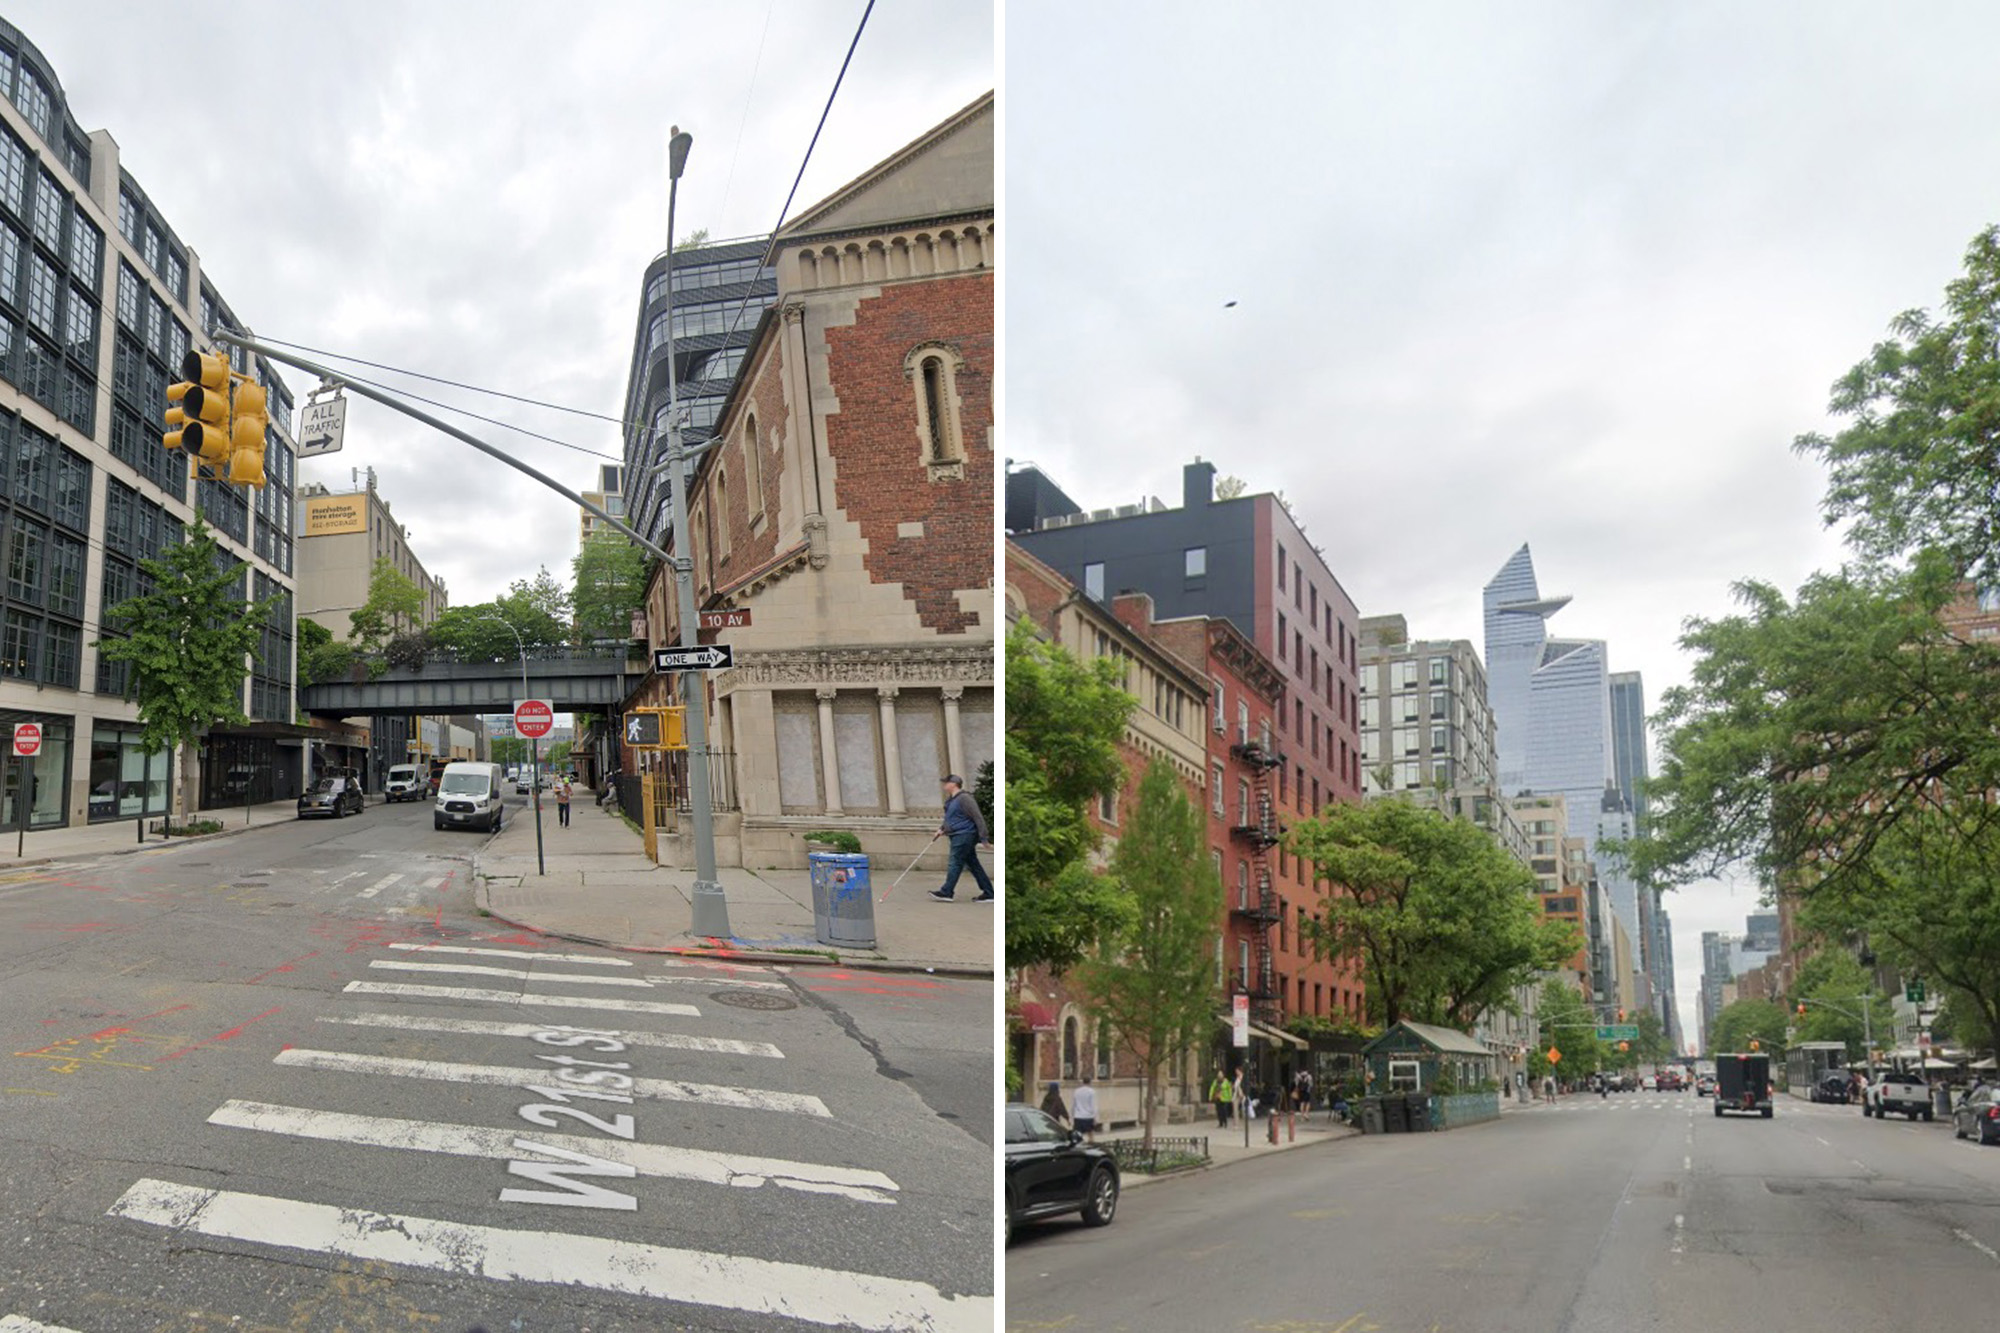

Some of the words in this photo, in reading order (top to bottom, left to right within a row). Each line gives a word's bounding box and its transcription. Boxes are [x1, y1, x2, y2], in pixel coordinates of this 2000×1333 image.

[310, 405, 335, 421] ALL
[303, 418, 341, 436] TRAFFIC
[328, 511, 357, 519] storage
[707, 614, 722, 626] 10
[665, 654, 688, 665] ONE
[696, 653, 719, 663] WAY
